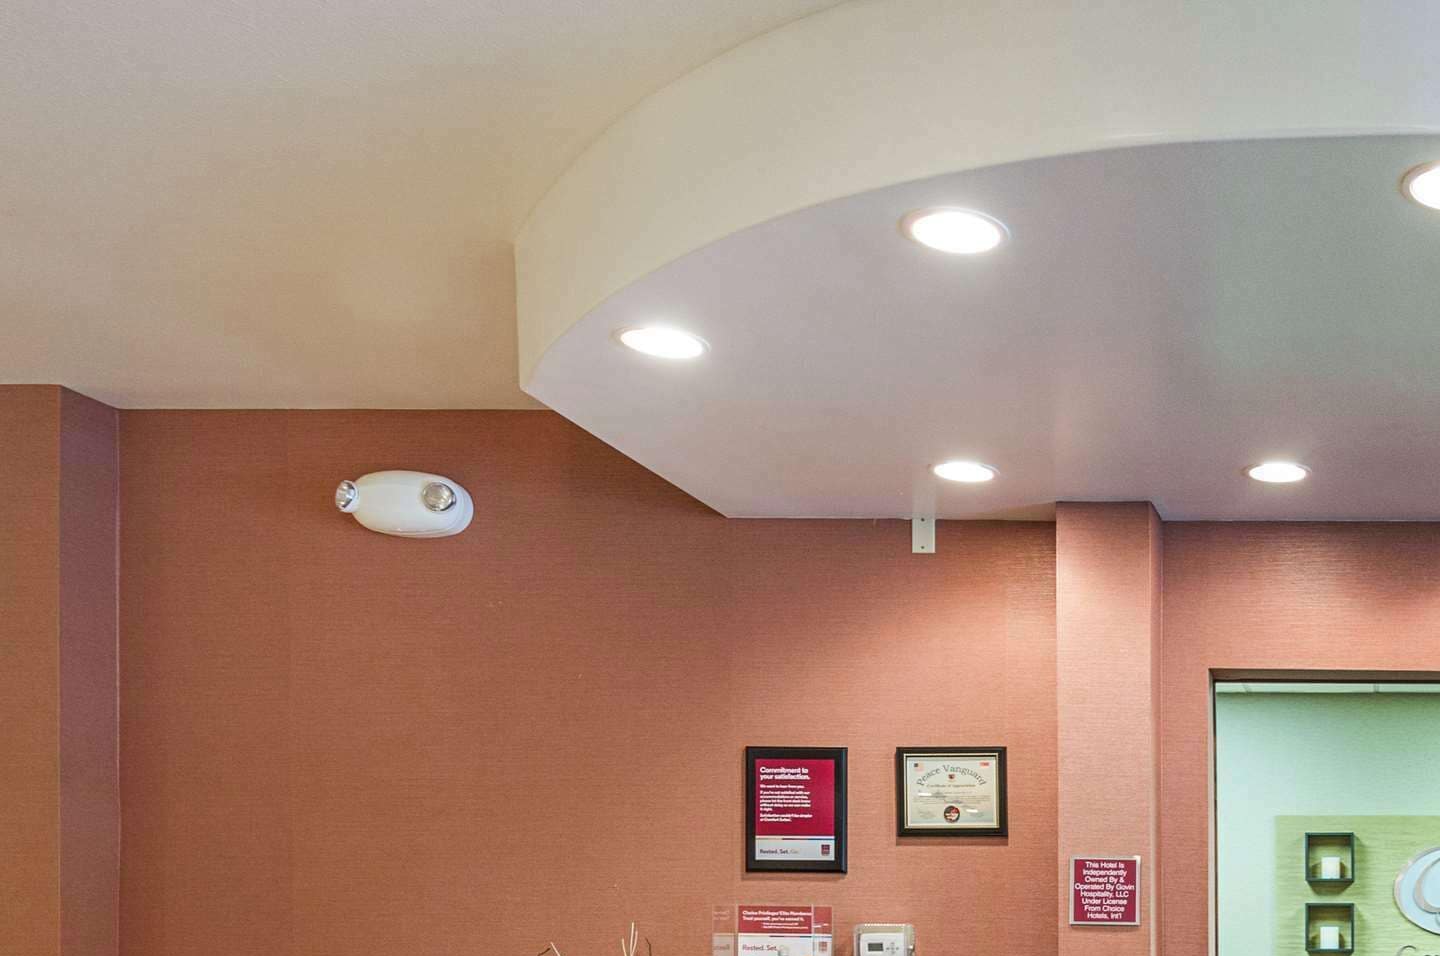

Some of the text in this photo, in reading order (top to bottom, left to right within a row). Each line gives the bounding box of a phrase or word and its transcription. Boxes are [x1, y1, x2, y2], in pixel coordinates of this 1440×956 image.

[759, 766, 801, 774] Commitment
[916, 768, 941, 786] Peace
[1082, 869, 1127, 877] Independently
[1109, 876, 1118, 884] By
[1074, 883, 1104, 891] Operated
[1106, 883, 1115, 891] By
